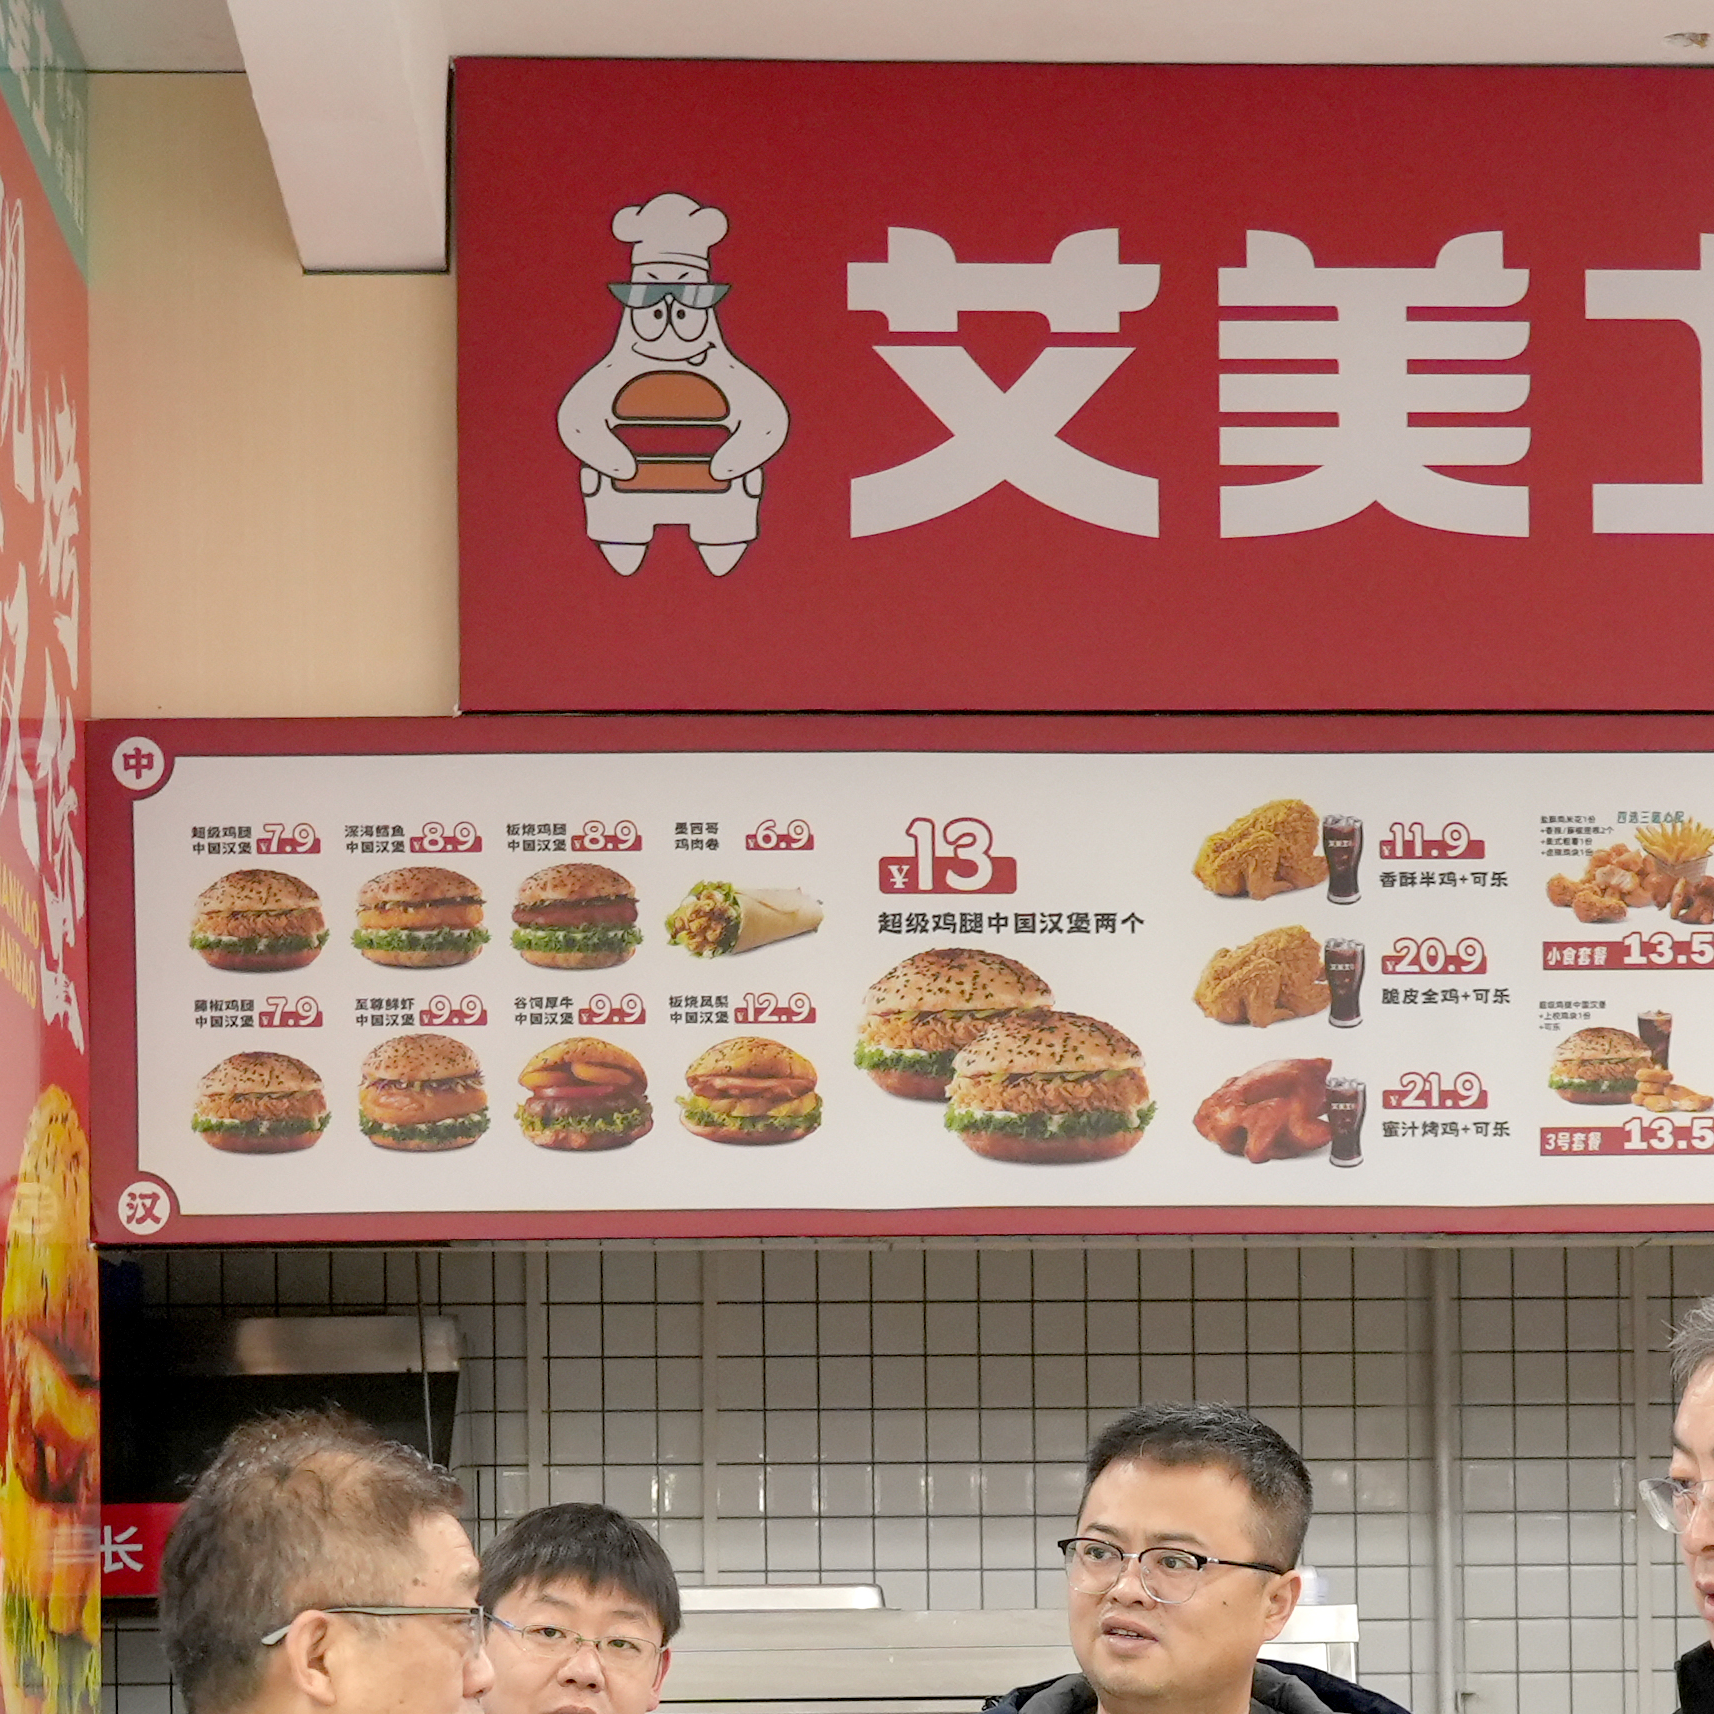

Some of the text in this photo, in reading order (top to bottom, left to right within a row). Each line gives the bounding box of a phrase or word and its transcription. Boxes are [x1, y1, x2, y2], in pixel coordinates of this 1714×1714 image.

[121, 745, 156, 780] 中
[674, 822, 720, 835] 墨西哥
[192, 842, 252, 855] 中国汉堡
[345, 841, 406, 854] 中国汉堡
[507, 839, 567, 852] 中国汉堡
[674, 838, 720, 851] 鸡肉卷
[1379, 871, 1509, 888] 香酥半鸡+可乐
[878, 912, 1145, 935] 超级鸡腿中国汉堡两个
[1623, 932, 1714, 965] 13.5
[1381, 988, 1511, 1006] 脆皮全鸡+可乐
[195, 1015, 255, 1028] 中国汉堡
[355, 1014, 416, 1027] 中国汉堡
[514, 1012, 575, 1025] 中国汉堡
[670, 1011, 730, 1024] 中国汉堡
[1382, 1120, 1511, 1138] 蜜汁烤鸡+可乐
[1545, 1132, 1602, 1151] 3号套餐
[125, 1191, 163, 1226] 汉
